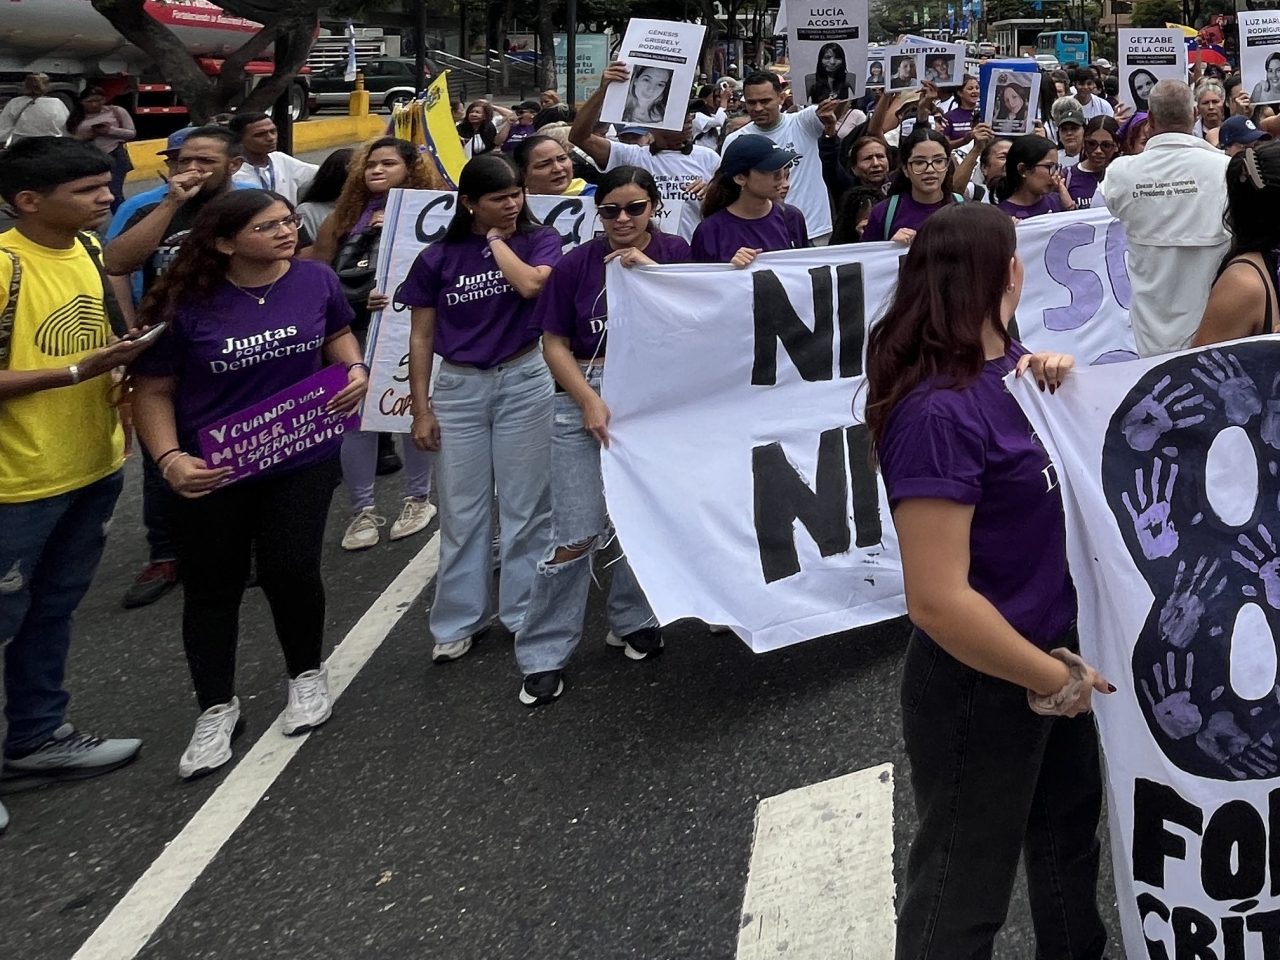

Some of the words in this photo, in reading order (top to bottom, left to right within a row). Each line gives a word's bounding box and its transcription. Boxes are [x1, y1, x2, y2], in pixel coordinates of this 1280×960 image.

[810, 7, 845, 17] LUCÍA
[807, 19, 849, 27] ACOSTA
[1245, 18, 1260, 26] LUZ
[648, 29, 680, 38] GÉNESIS
[644, 37, 681, 46] GRISBELY
[1130, 36, 1173, 44] GETZABE
[638, 43, 683, 54] RODRÍGUEZ
[900, 46, 947, 55] LIBERTAD
[1128, 45, 1140, 53] DE
[1141, 45, 1152, 53] LA
[1154, 45, 1176, 53] CRUZ
[666, 182, 692, 191] PRES
[1139, 189, 1165, 198] Presidente
[1174, 186, 1198, 196] Venezuela
[455, 269, 504, 289] Junta
[464, 283, 486, 292] POR
[486, 279, 500, 287] LA
[751, 261, 865, 386] NI
[221, 324, 298, 355] Juntas
[235, 345, 263, 358] POR
[265, 340, 280, 349] LA
[209, 424, 227, 444] Y
[230, 398, 296, 438] CUANDO
[298, 386, 326, 404] una
[211, 422, 286, 466] MUJER
[237, 422, 317, 467] ESPERANZA
[258, 419, 345, 470] DEVOLVIÓ
